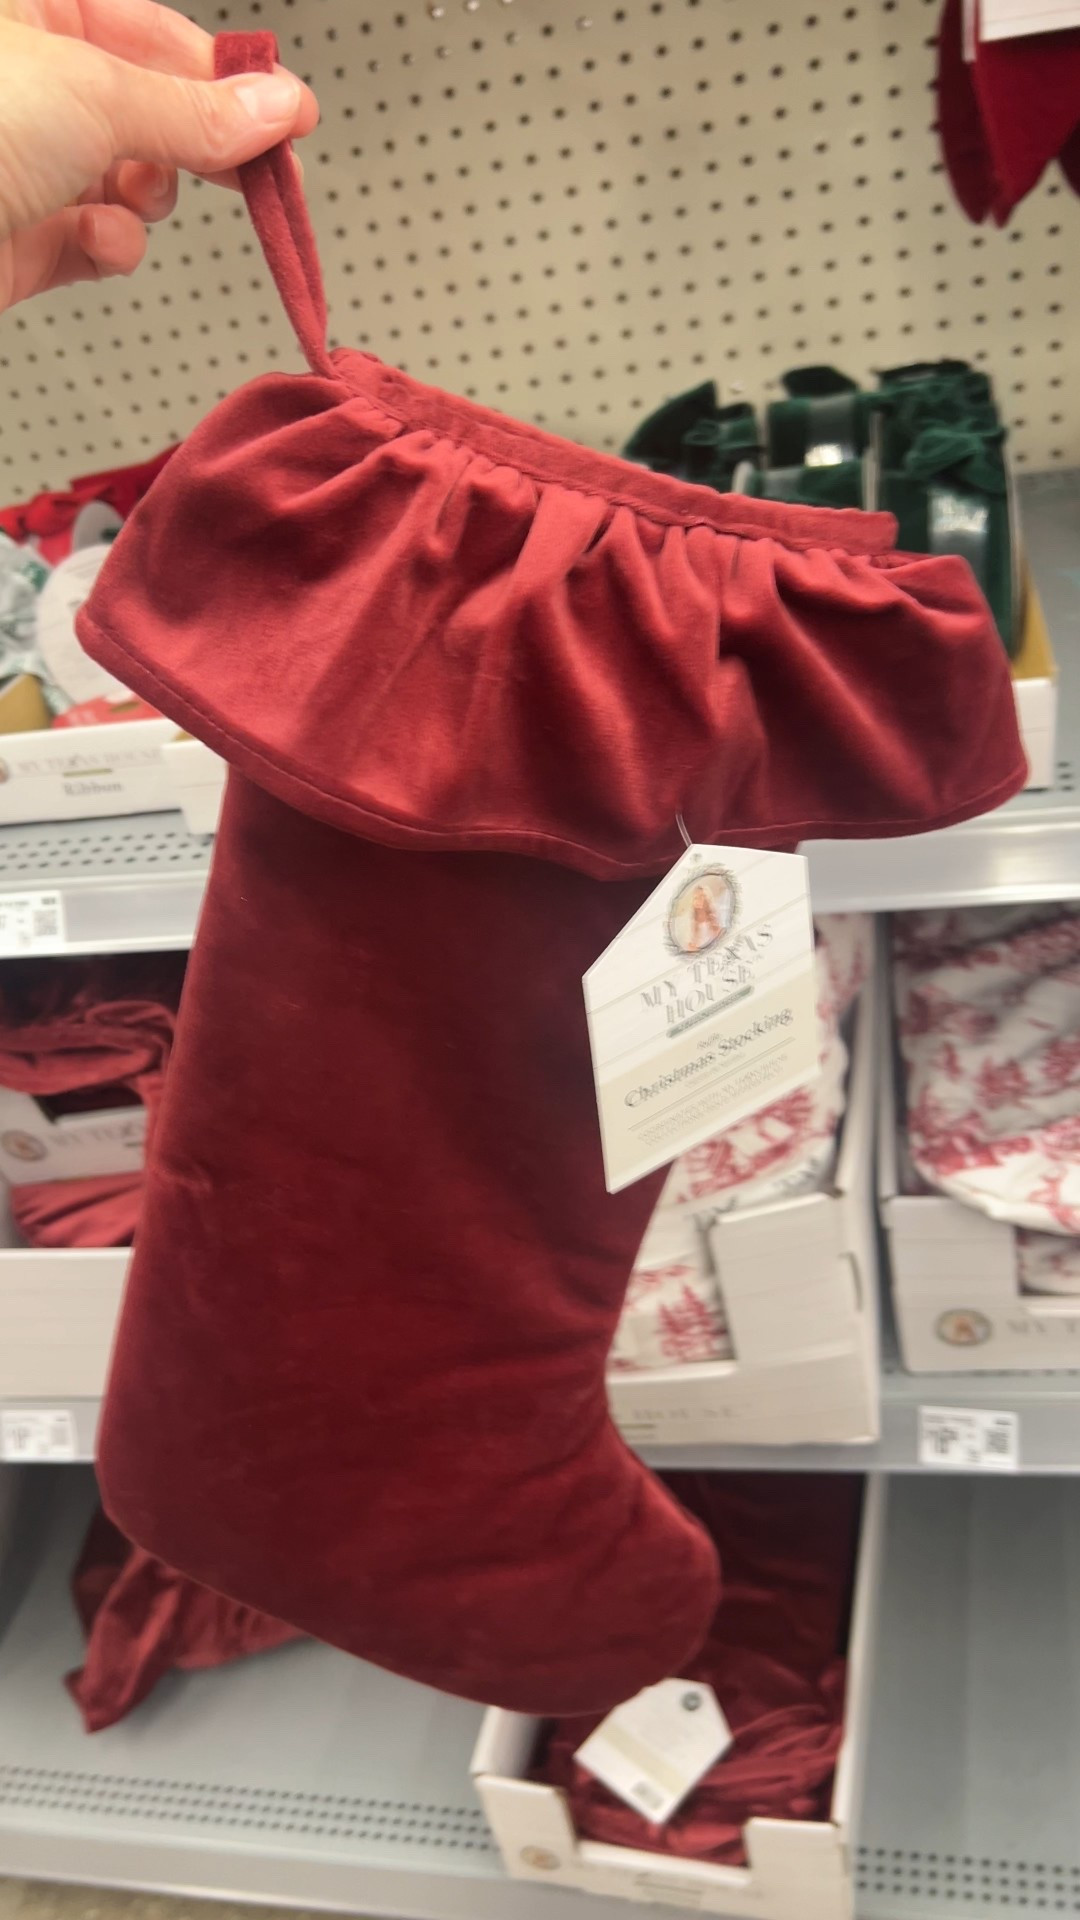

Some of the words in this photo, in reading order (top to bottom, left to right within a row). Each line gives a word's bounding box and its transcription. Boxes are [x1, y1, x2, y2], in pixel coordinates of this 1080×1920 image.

[63, 781, 124, 796] Ribbon
[640, 980, 678, 1009] MY
[688, 924, 773, 983] TEXAS
[666, 957, 758, 1024] HOUSE
[624, 1052, 716, 1108] Christmas
[717, 1008, 794, 1057] Stocking
